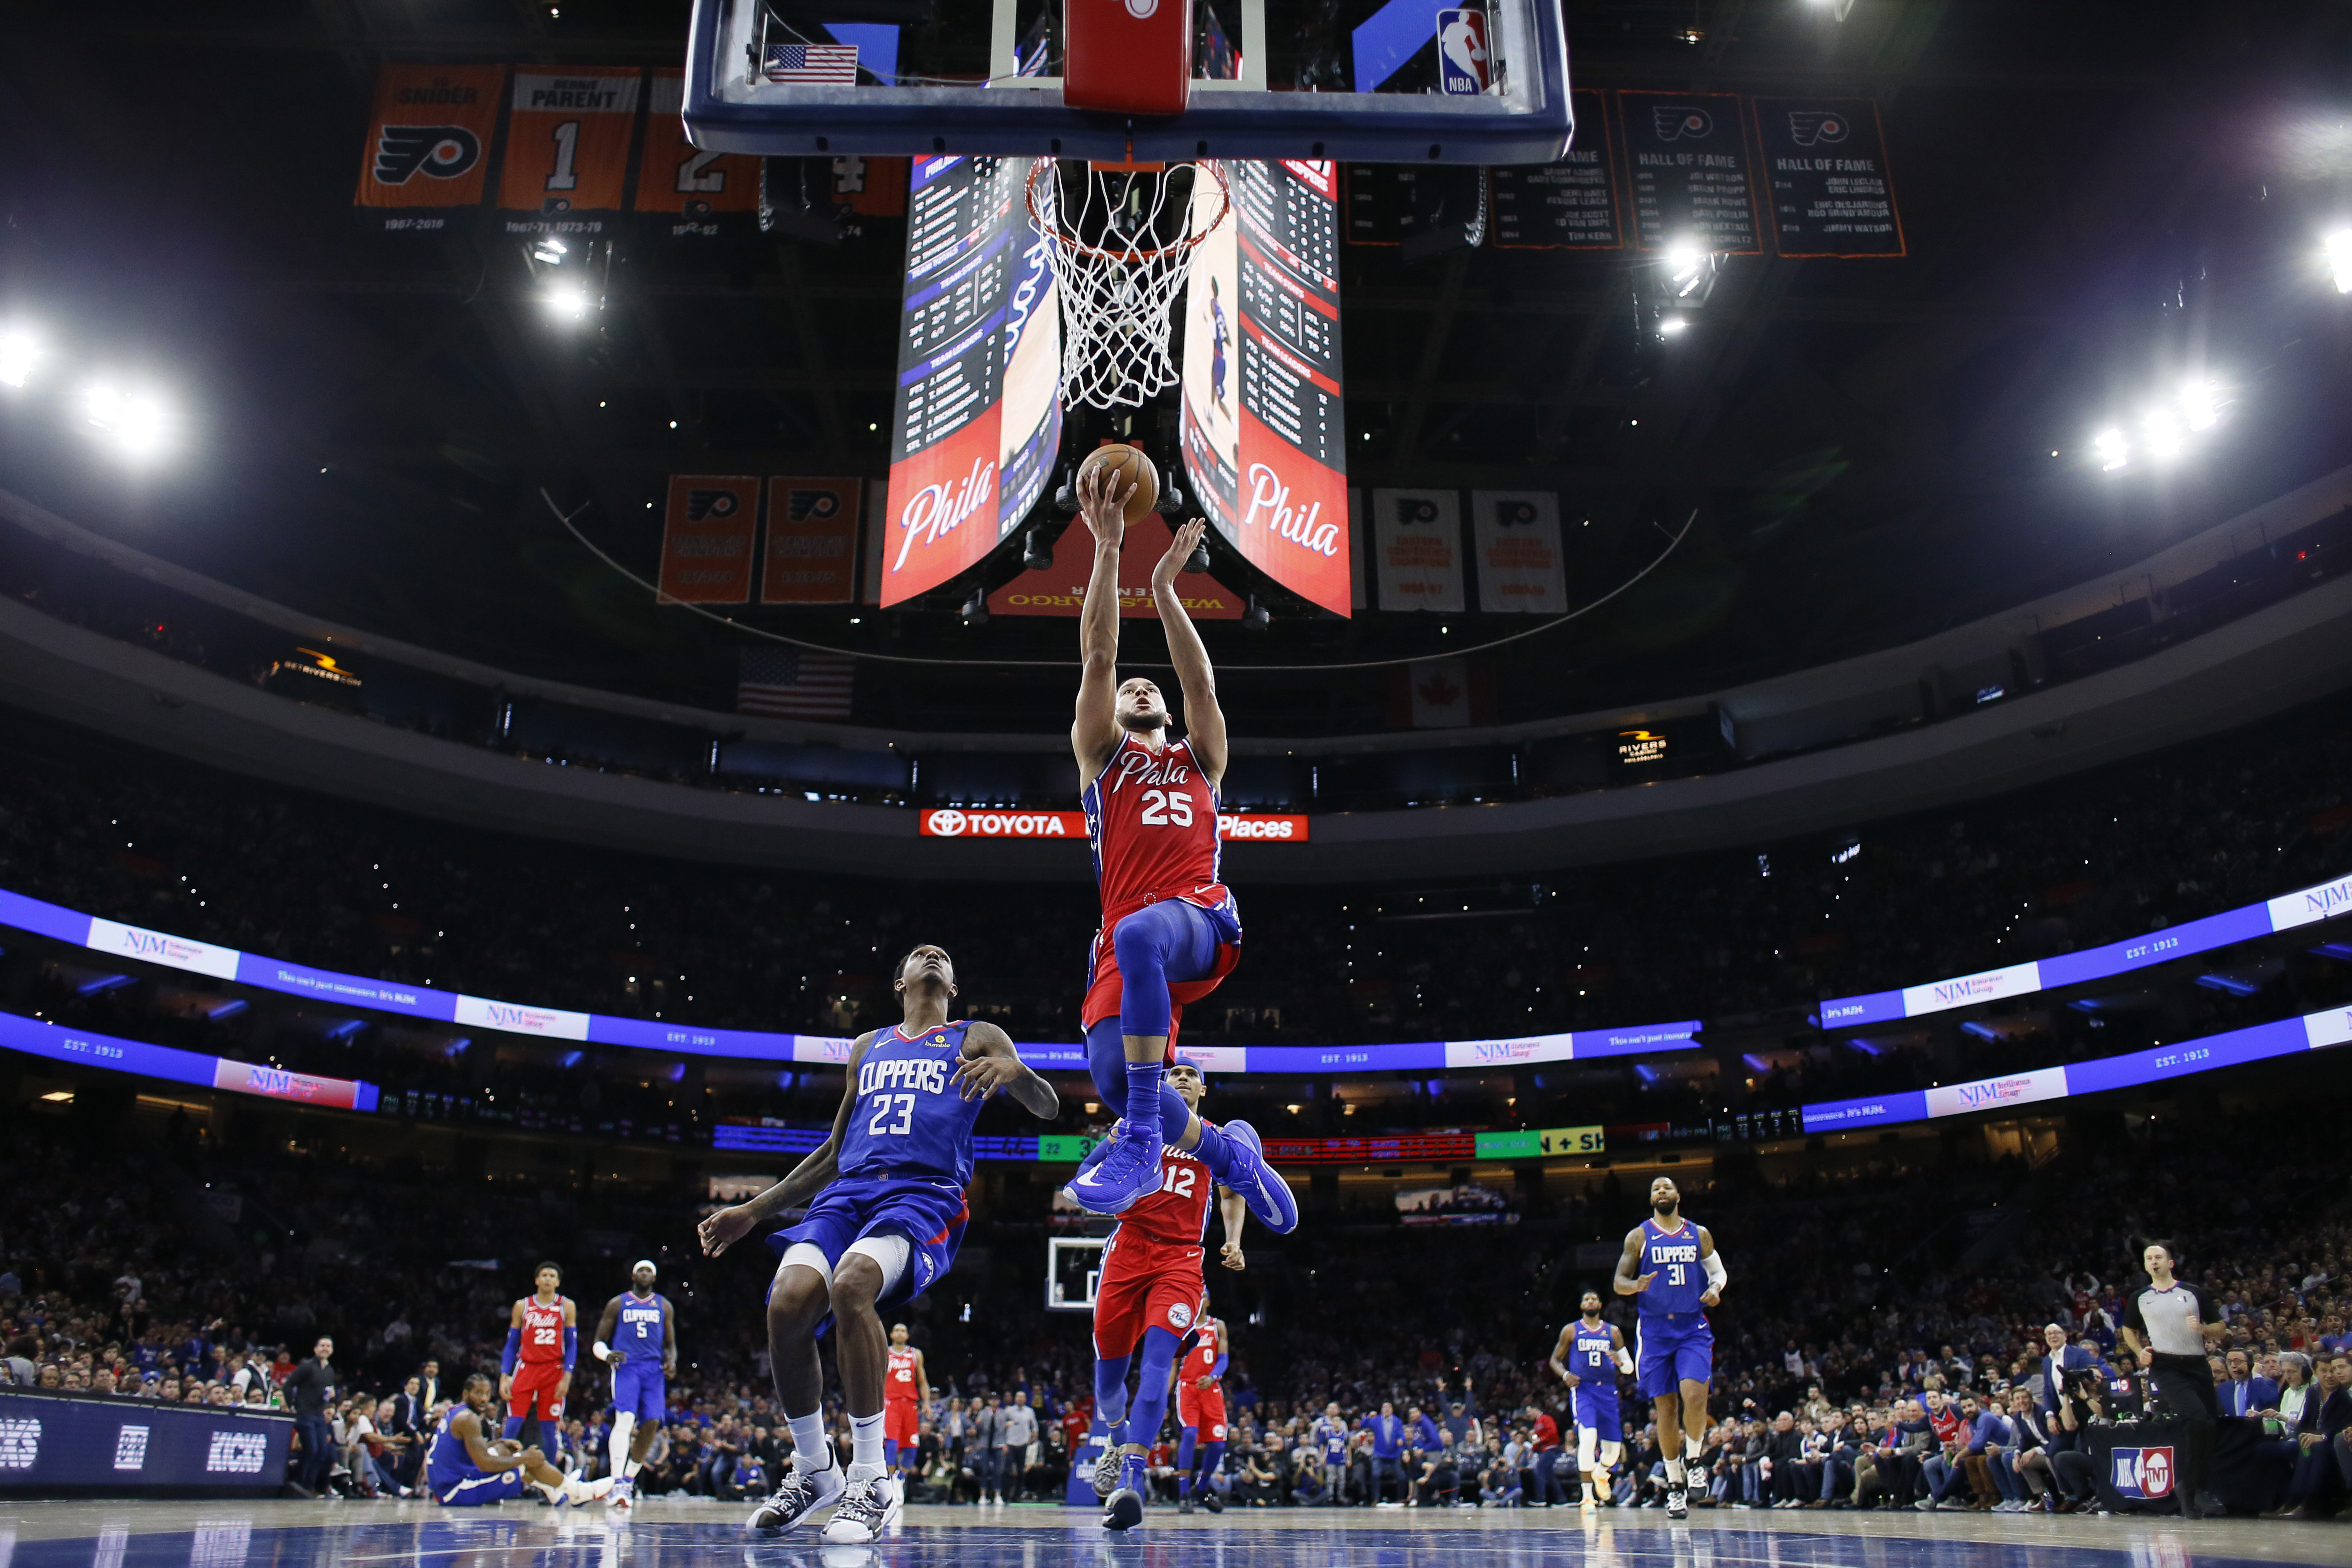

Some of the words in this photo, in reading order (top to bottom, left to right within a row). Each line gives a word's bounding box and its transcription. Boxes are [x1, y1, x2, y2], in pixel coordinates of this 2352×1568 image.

[1449, 77, 1472, 92] NBA
[531, 90, 616, 108] PARENT
[545, 120, 580, 191] 1
[1639, 153, 1675, 166] HALL
[1676, 153, 1694, 166] OF
[1697, 154, 1736, 167] FAME
[1777, 158, 1813, 170] HALL
[1814, 158, 1833, 171] OF
[1835, 159, 1875, 172] FAME
[925, 186, 969, 219] RICHARDSON
[926, 185, 952, 206] HARRIS
[924, 207, 958, 233] SIMMONS
[923, 222, 957, 247] HORFORD
[922, 234, 956, 260] THYBULLE
[1260, 304, 1271, 319] 1/2
[909, 322, 925, 337] 3PT
[930, 349, 953, 368] TEAM
[952, 328, 983, 356] LEADERS
[1307, 340, 1320, 352] TO
[1323, 336, 1330, 345] 2
[928, 373, 964, 400] T.HARRIS
[906, 410, 923, 425] AST
[927, 382, 971, 414] B.SIMMONS
[906, 424, 923, 439] BLK
[1319, 422, 1326, 431] 4
[906, 439, 921, 453] STL
[891, 457, 995, 574] Phila
[1244, 463, 1339, 557] Phila
[1008, 594, 1084, 606] ARGO
[1619, 740, 1667, 755] RIVERS
[1112, 750, 1189, 793] Phila
[1141, 790, 1193, 827] 25
[968, 815, 1065, 835] TOYOTA
[1219, 815, 1293, 838] Places
[2305, 882, 2350, 914] NJM
[124, 930, 166, 955] NJM
[2126, 946, 2151, 959] EST.
[2152, 937, 2179, 952] 1913
[278, 970, 296, 984] This
[1933, 980, 1972, 1004] NJM
[487, 1004, 523, 1026] NJM
[63, 1038, 91, 1054] EST.
[93, 1043, 124, 1060] 1913
[1475, 1043, 1511, 1062] NJM
[2155, 1055, 2181, 1068] EST.
[2183, 1048, 2210, 1062] 1913
[248, 1069, 291, 1093] NJM
[858, 1059, 948, 1096] CLIPPERS
[1957, 1083, 1999, 1108] NJM
[868, 1094, 916, 1136] 23
[1162, 1165, 1196, 1199] 12
[1651, 1245, 1697, 1264] CLIPPERS
[1668, 1264, 1685, 1286] 31
[523, 1312, 557, 1332] Phila
[622, 1309, 661, 1324] CLIPPERS
[534, 1328, 556, 1345] 22
[636, 1322, 648, 1338] 5
[1577, 1338, 1610, 1352] CLIPPERS
[1203, 1349, 1213, 1364] 0
[1588, 1350, 1602, 1367] 13
[895, 1369, 912, 1382] 42
[2116, 1458, 2137, 1488] NBA
